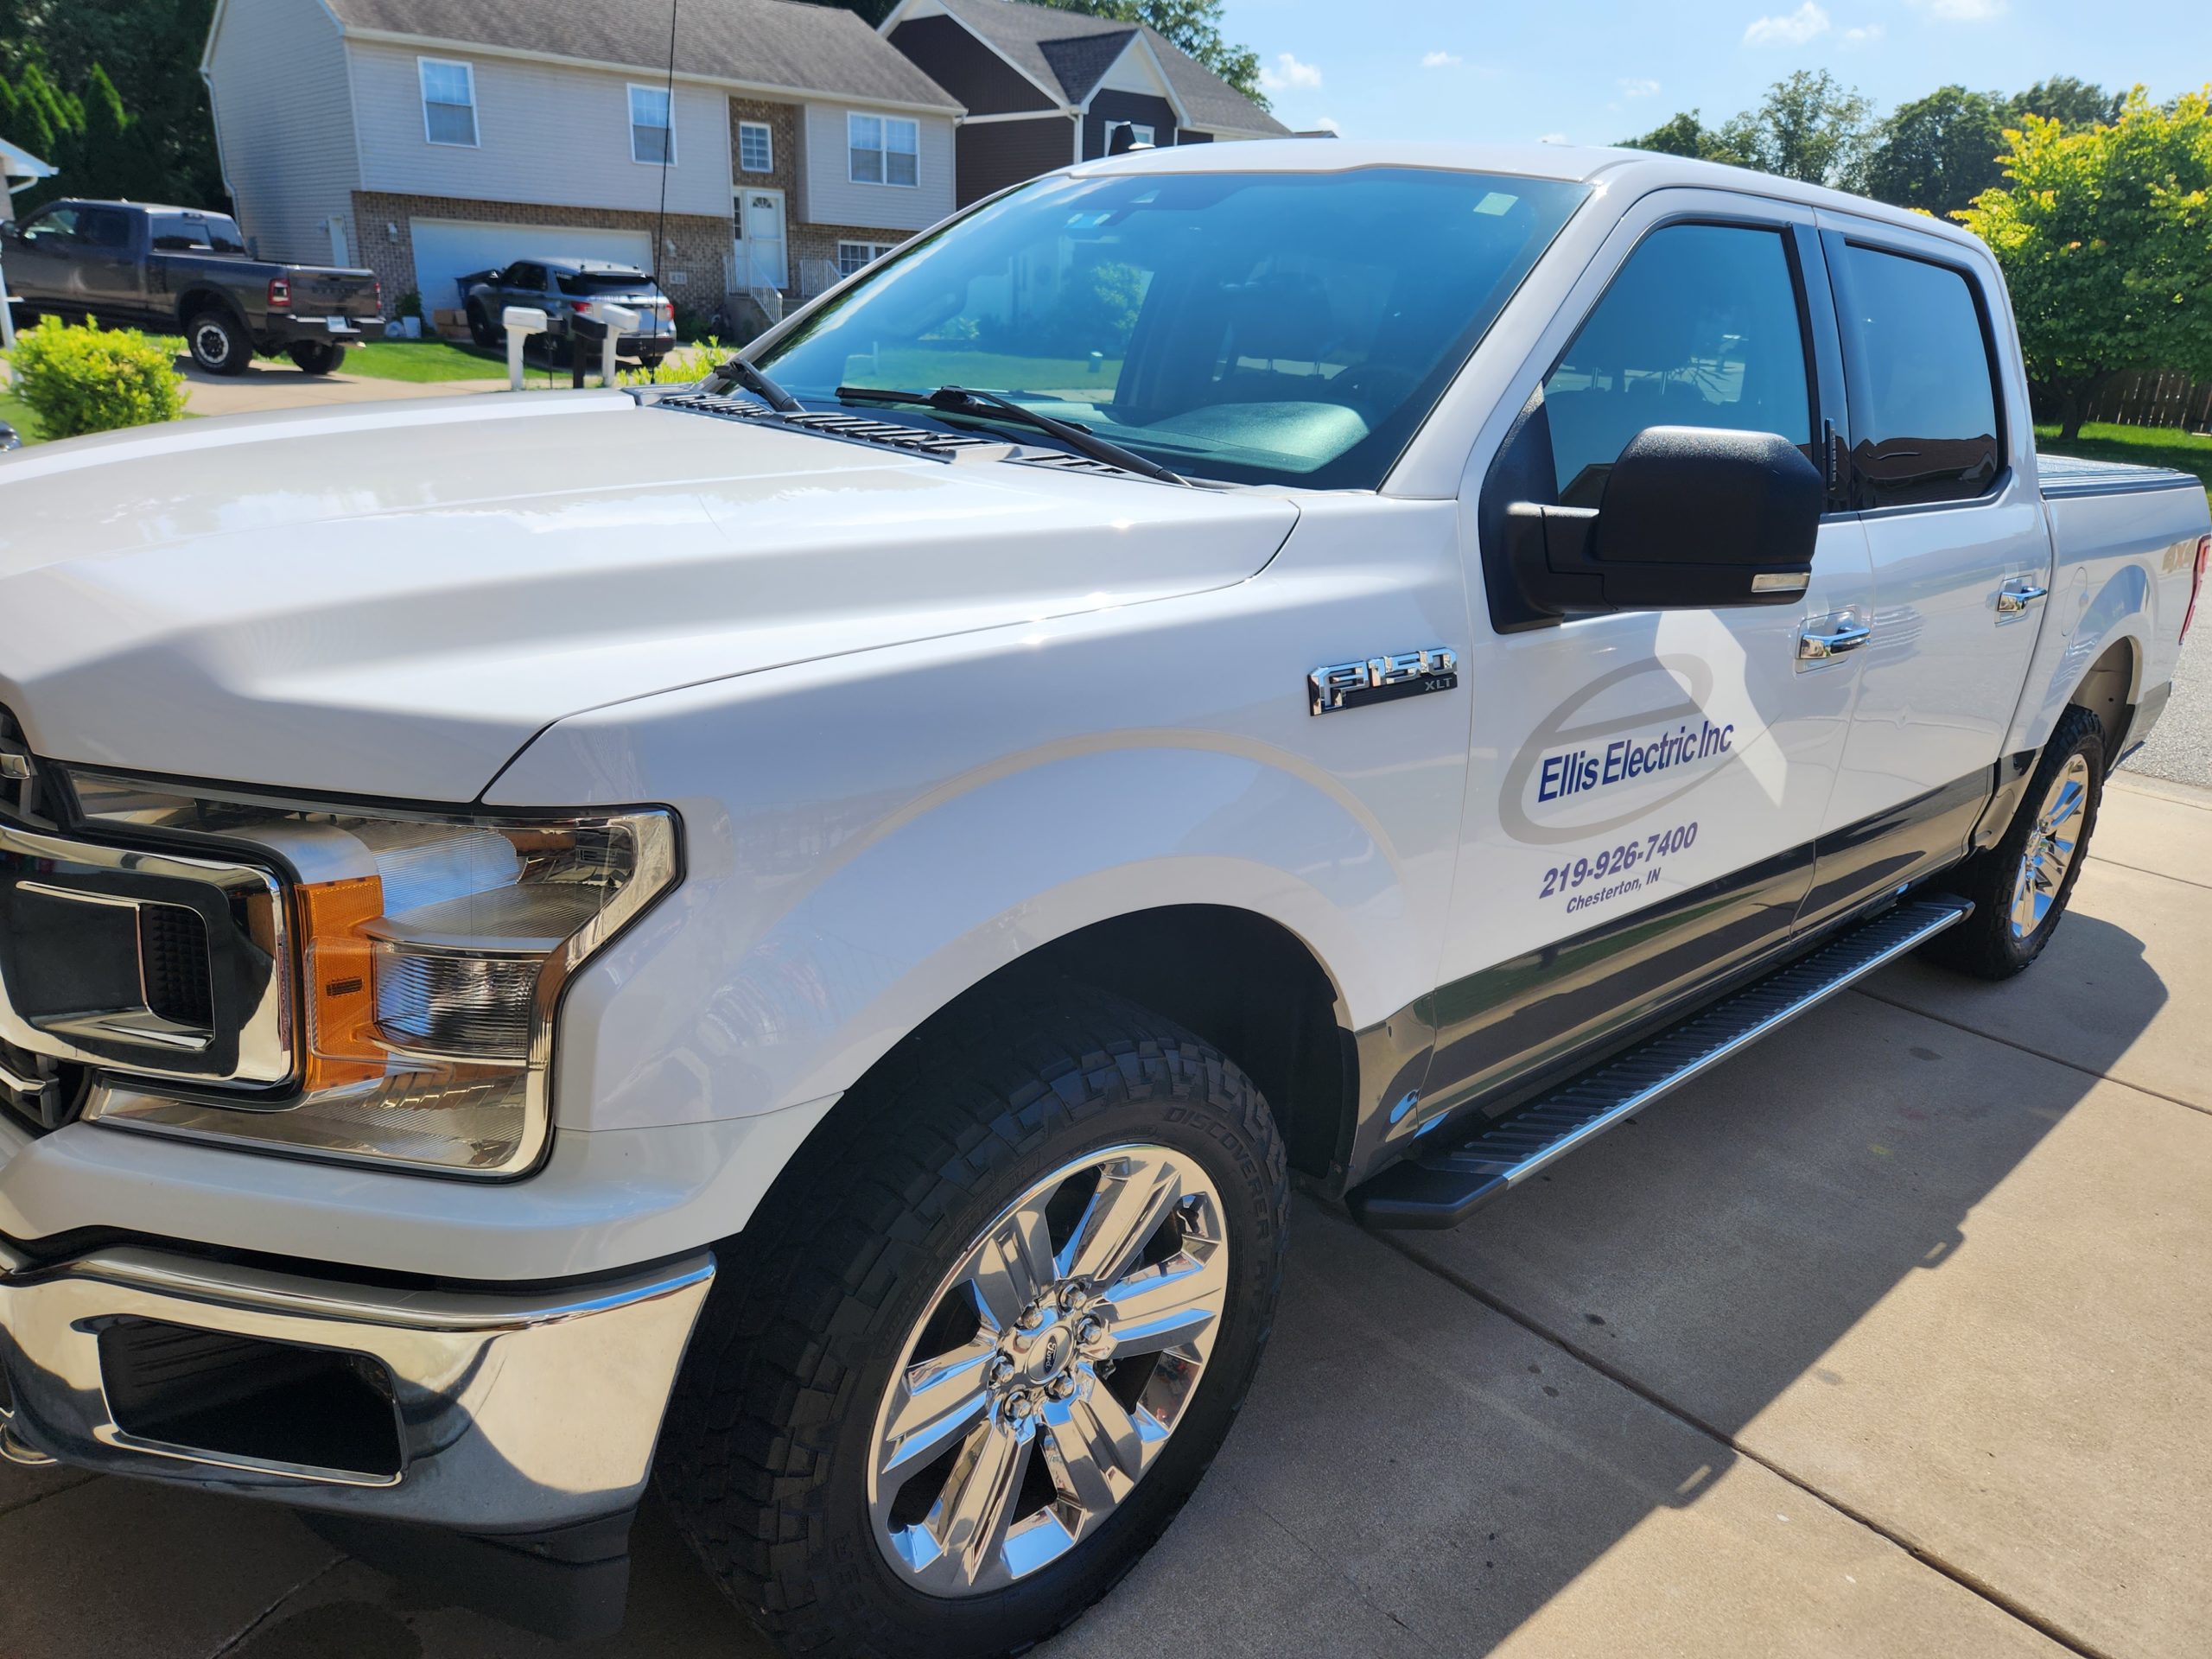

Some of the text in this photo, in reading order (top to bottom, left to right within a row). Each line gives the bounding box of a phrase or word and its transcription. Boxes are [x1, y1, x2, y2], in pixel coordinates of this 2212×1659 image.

[1425, 677, 1453, 692] XLT
[1538, 720, 1734, 803] Ellis Electric Inc
[1539, 822, 1698, 899] 219-926-7400
[1566, 867, 1662, 914] Chesterton, IN
[1166, 1106, 1269, 1239] DISCOVERER
[1045, 1340, 1058, 1370] Ford
